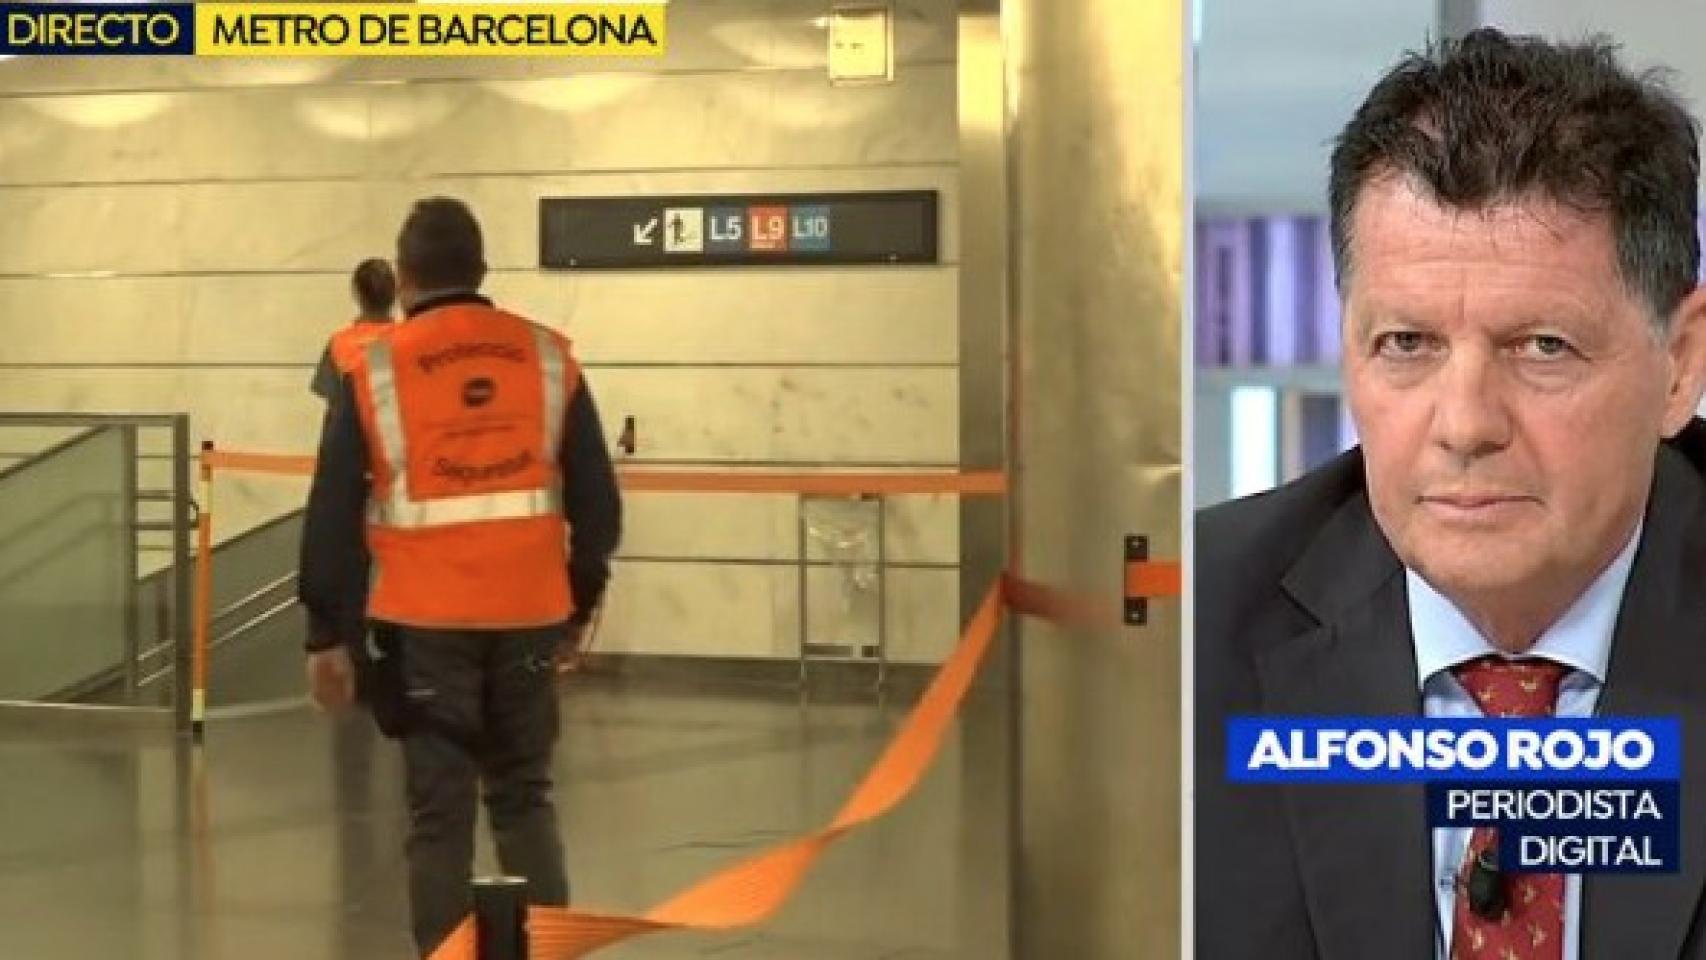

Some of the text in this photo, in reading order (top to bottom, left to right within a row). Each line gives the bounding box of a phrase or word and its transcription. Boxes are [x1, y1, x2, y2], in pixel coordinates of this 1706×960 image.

[711, 216, 828, 240] L5 L9 L10
